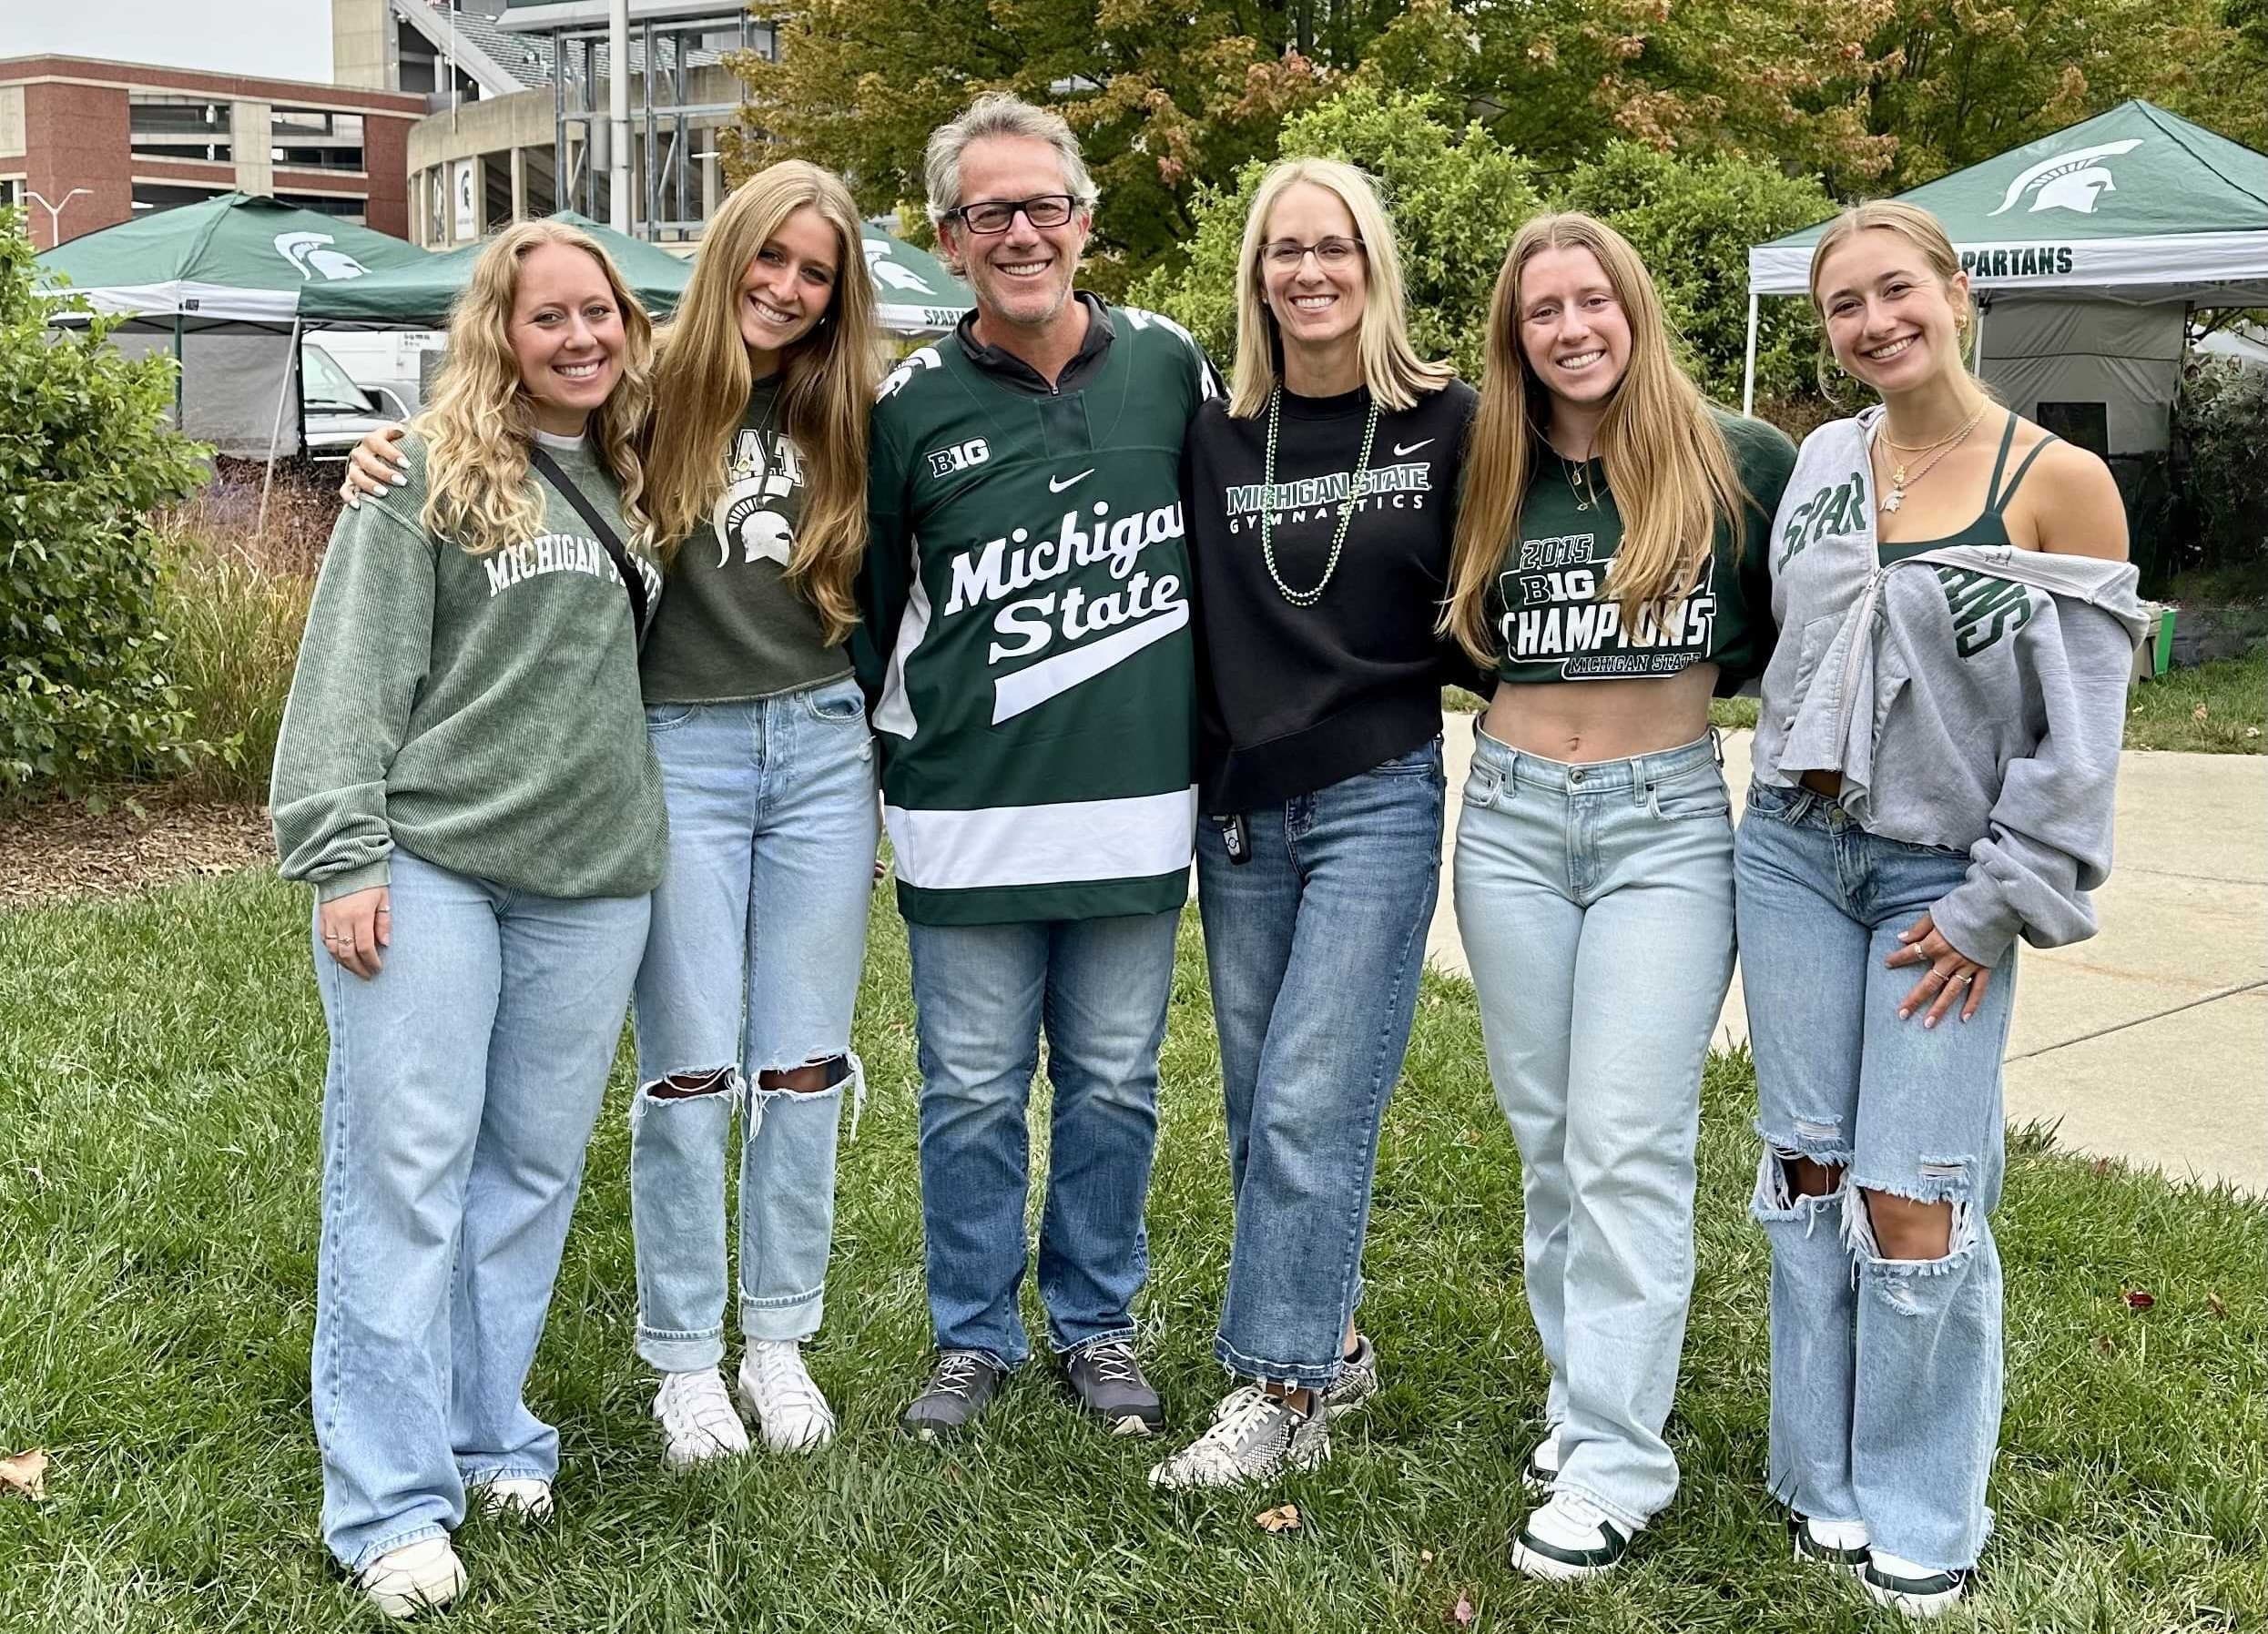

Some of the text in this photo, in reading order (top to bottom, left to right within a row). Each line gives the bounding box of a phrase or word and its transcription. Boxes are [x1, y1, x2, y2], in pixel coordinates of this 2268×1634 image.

[1956, 247, 2073, 277] PARTANS
[923, 309, 965, 327] SPART
[1226, 462, 1432, 516] MICHIGAN STATE
[1229, 494, 1423, 534] GYMNASTICS
[483, 533, 600, 598] MICHIGAN
[943, 500, 1185, 617] Michiga
[1520, 533, 1594, 571] 2015
[988, 570, 1182, 665] State
[1934, 565, 2031, 658] ANS
[1568, 655, 1650, 674] MICHIGAN
